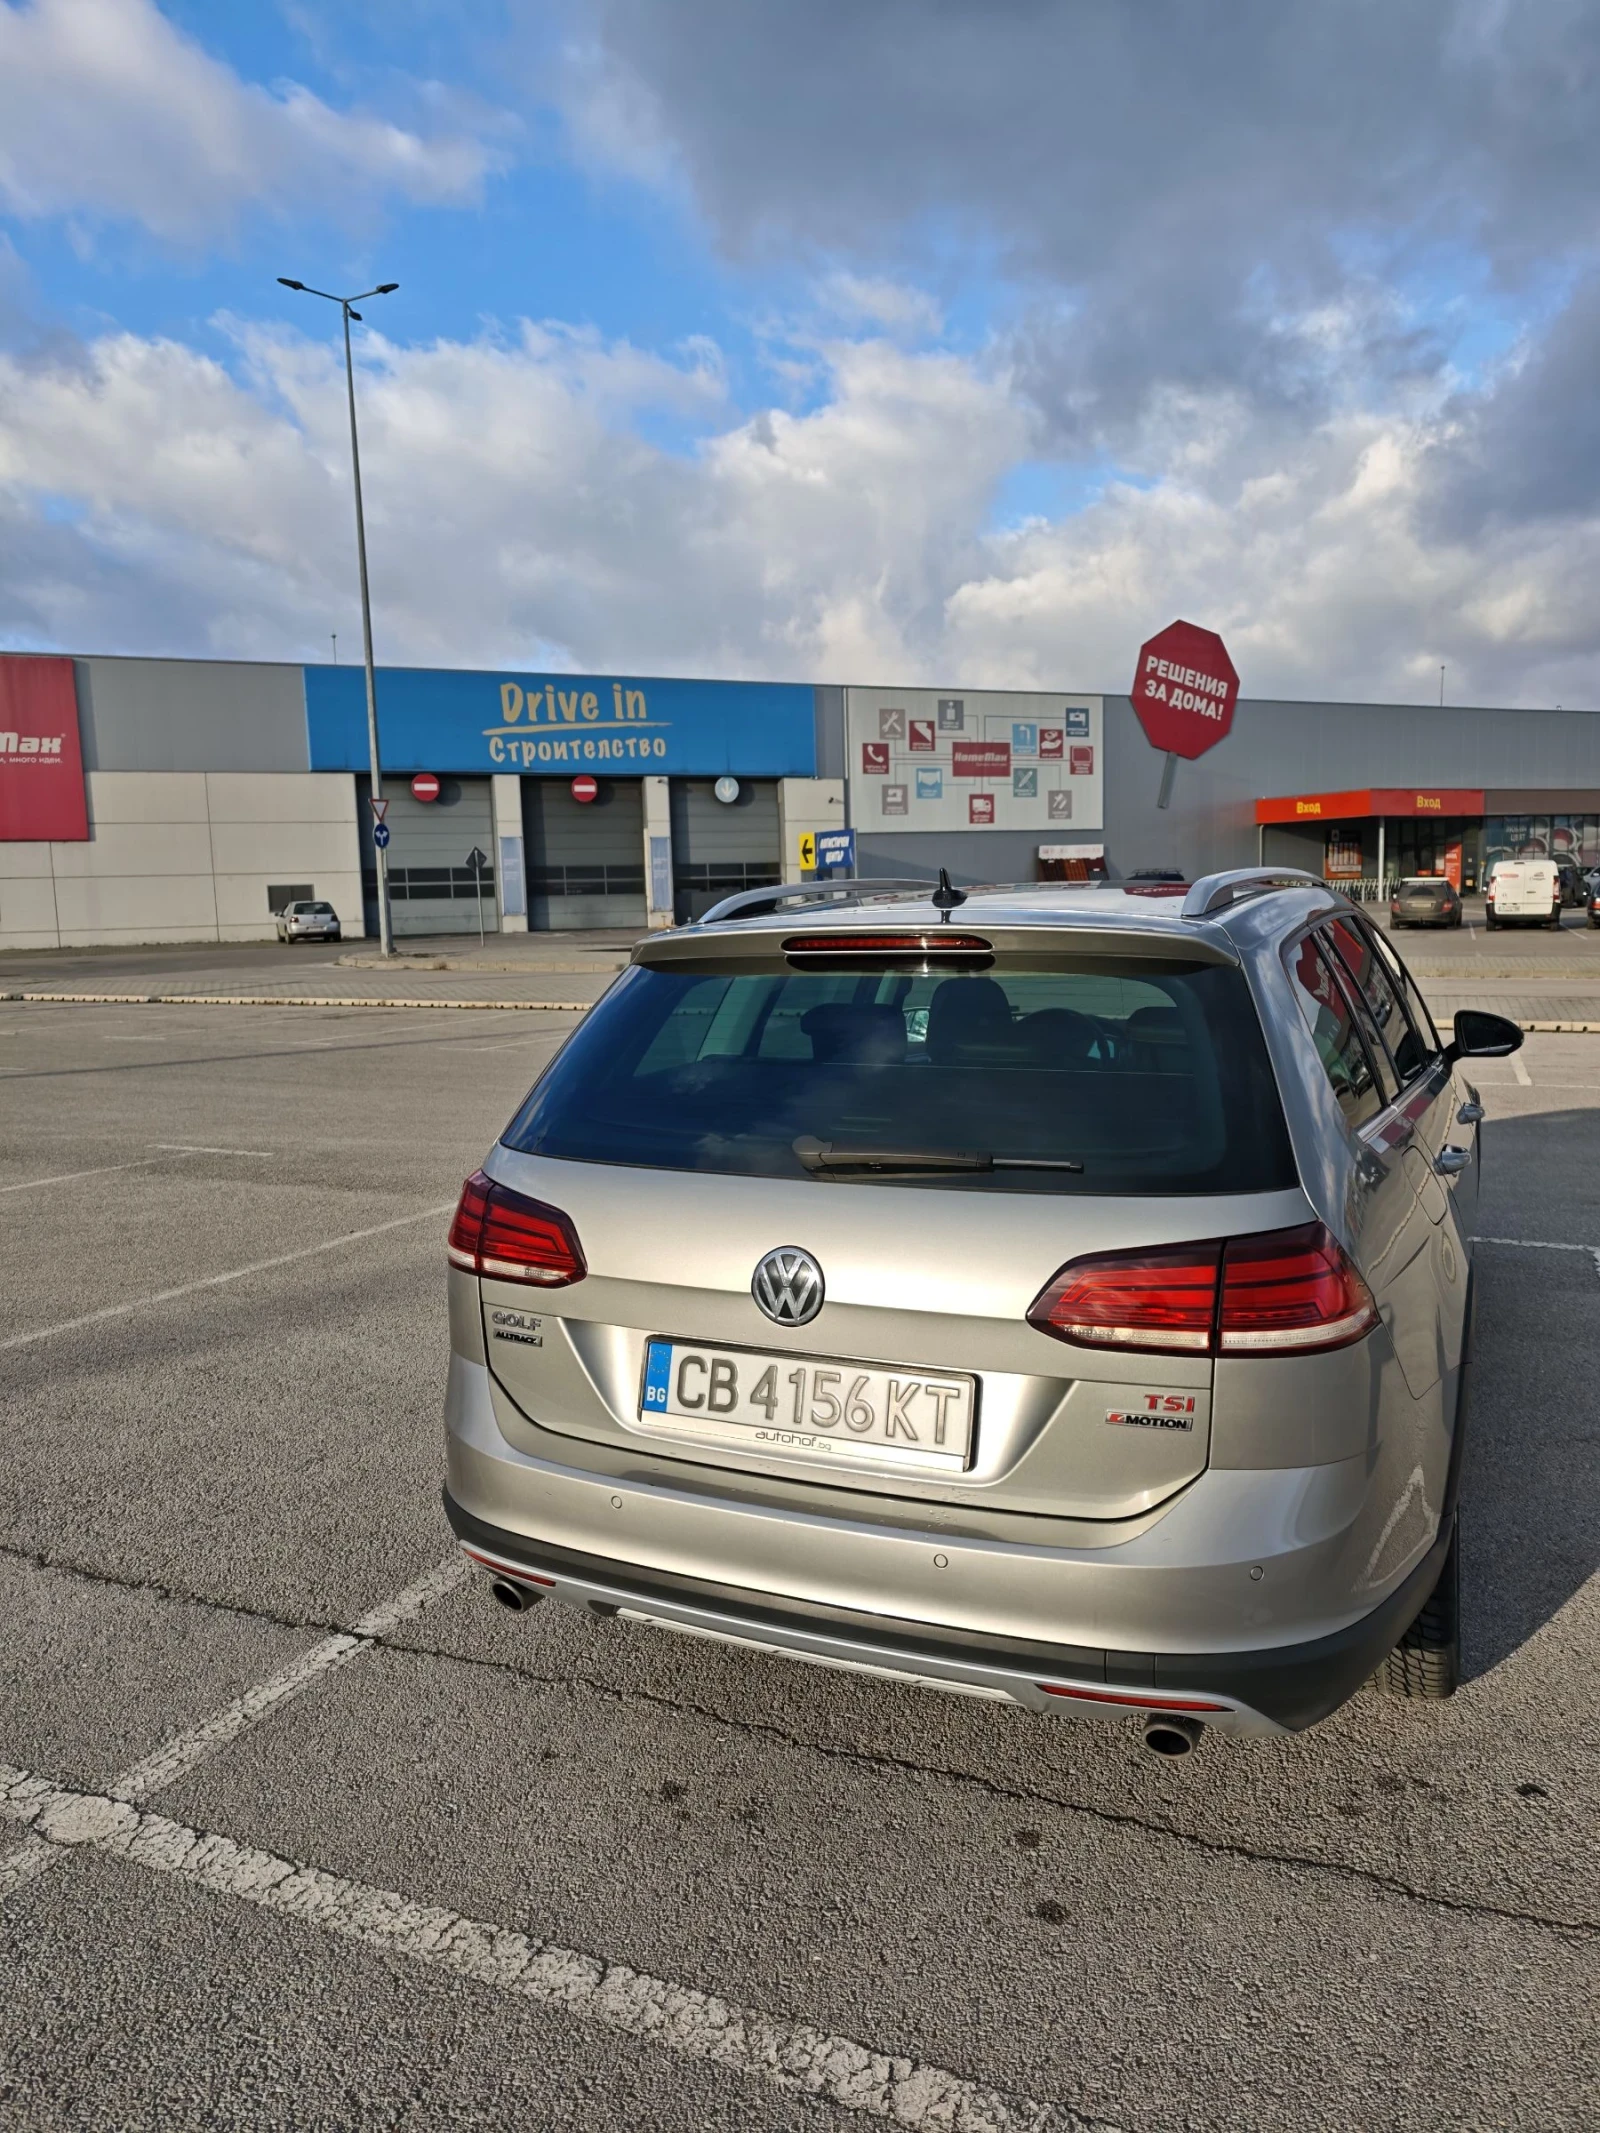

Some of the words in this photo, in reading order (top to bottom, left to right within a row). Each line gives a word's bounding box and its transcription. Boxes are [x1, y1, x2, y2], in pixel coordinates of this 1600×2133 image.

[1146, 655, 1228, 699] РЕШЕНИЯ
[500, 682, 599, 723] Drive
[613, 683, 647, 720] in
[1145, 679, 1166, 702] ЗА
[1169, 688, 1224, 721] ДОМА!
[489, 736, 667, 768] Строителство
[954, 752, 1008, 762] HomeMax
[1296, 801, 1321, 814] Вход
[1416, 795, 1441, 809] Вход
[492, 1311, 542, 1331] GOLF
[646, 1386, 667, 1404] BG
[675, 1355, 739, 1413] CB
[749, 1364, 875, 1433] 4156
[885, 1379, 960, 1445] KT
[1144, 1394, 1196, 1412] TSI
[755, 1429, 832, 1452] autohof.bg
